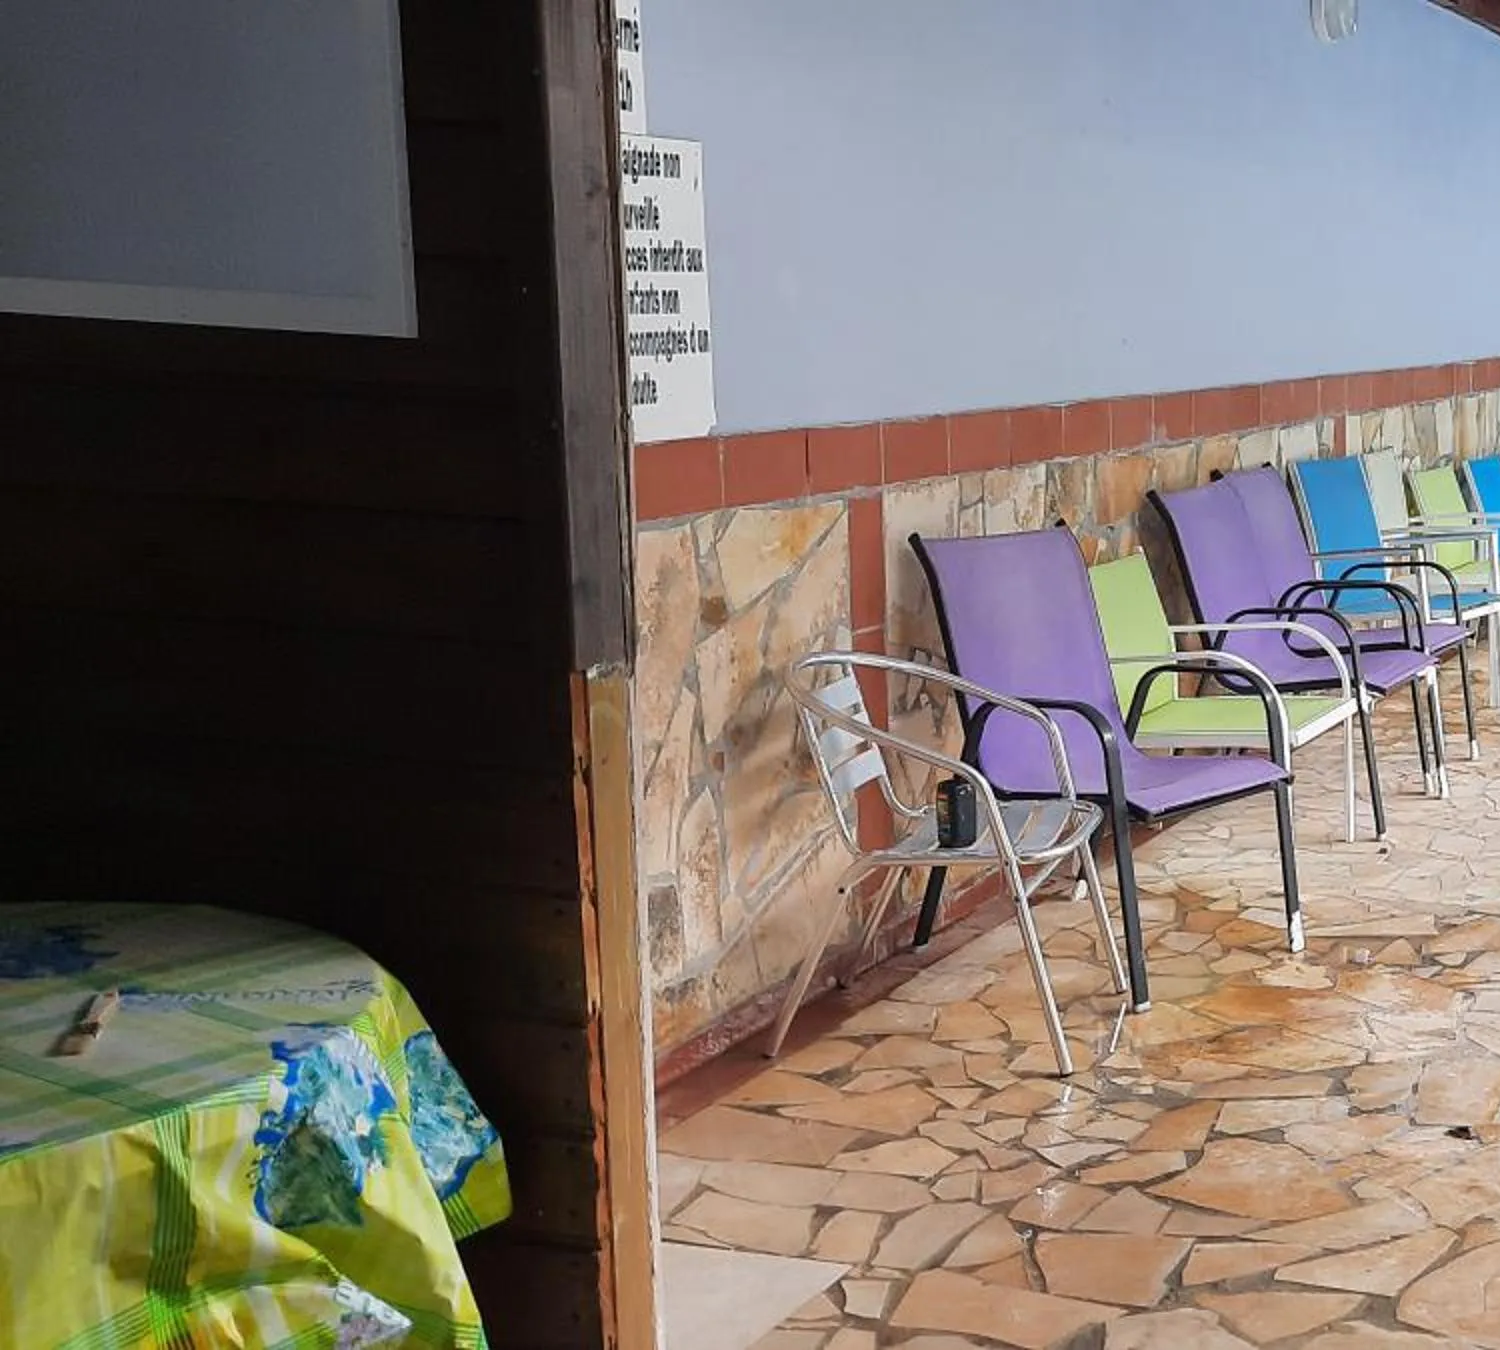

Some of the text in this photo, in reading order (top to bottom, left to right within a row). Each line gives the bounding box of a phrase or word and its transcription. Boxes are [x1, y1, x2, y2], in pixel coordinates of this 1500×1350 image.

[663, 152, 680, 178] non
[649, 238, 685, 272] interdit
[686, 247, 704, 272] aux
[662, 289, 680, 314] non
